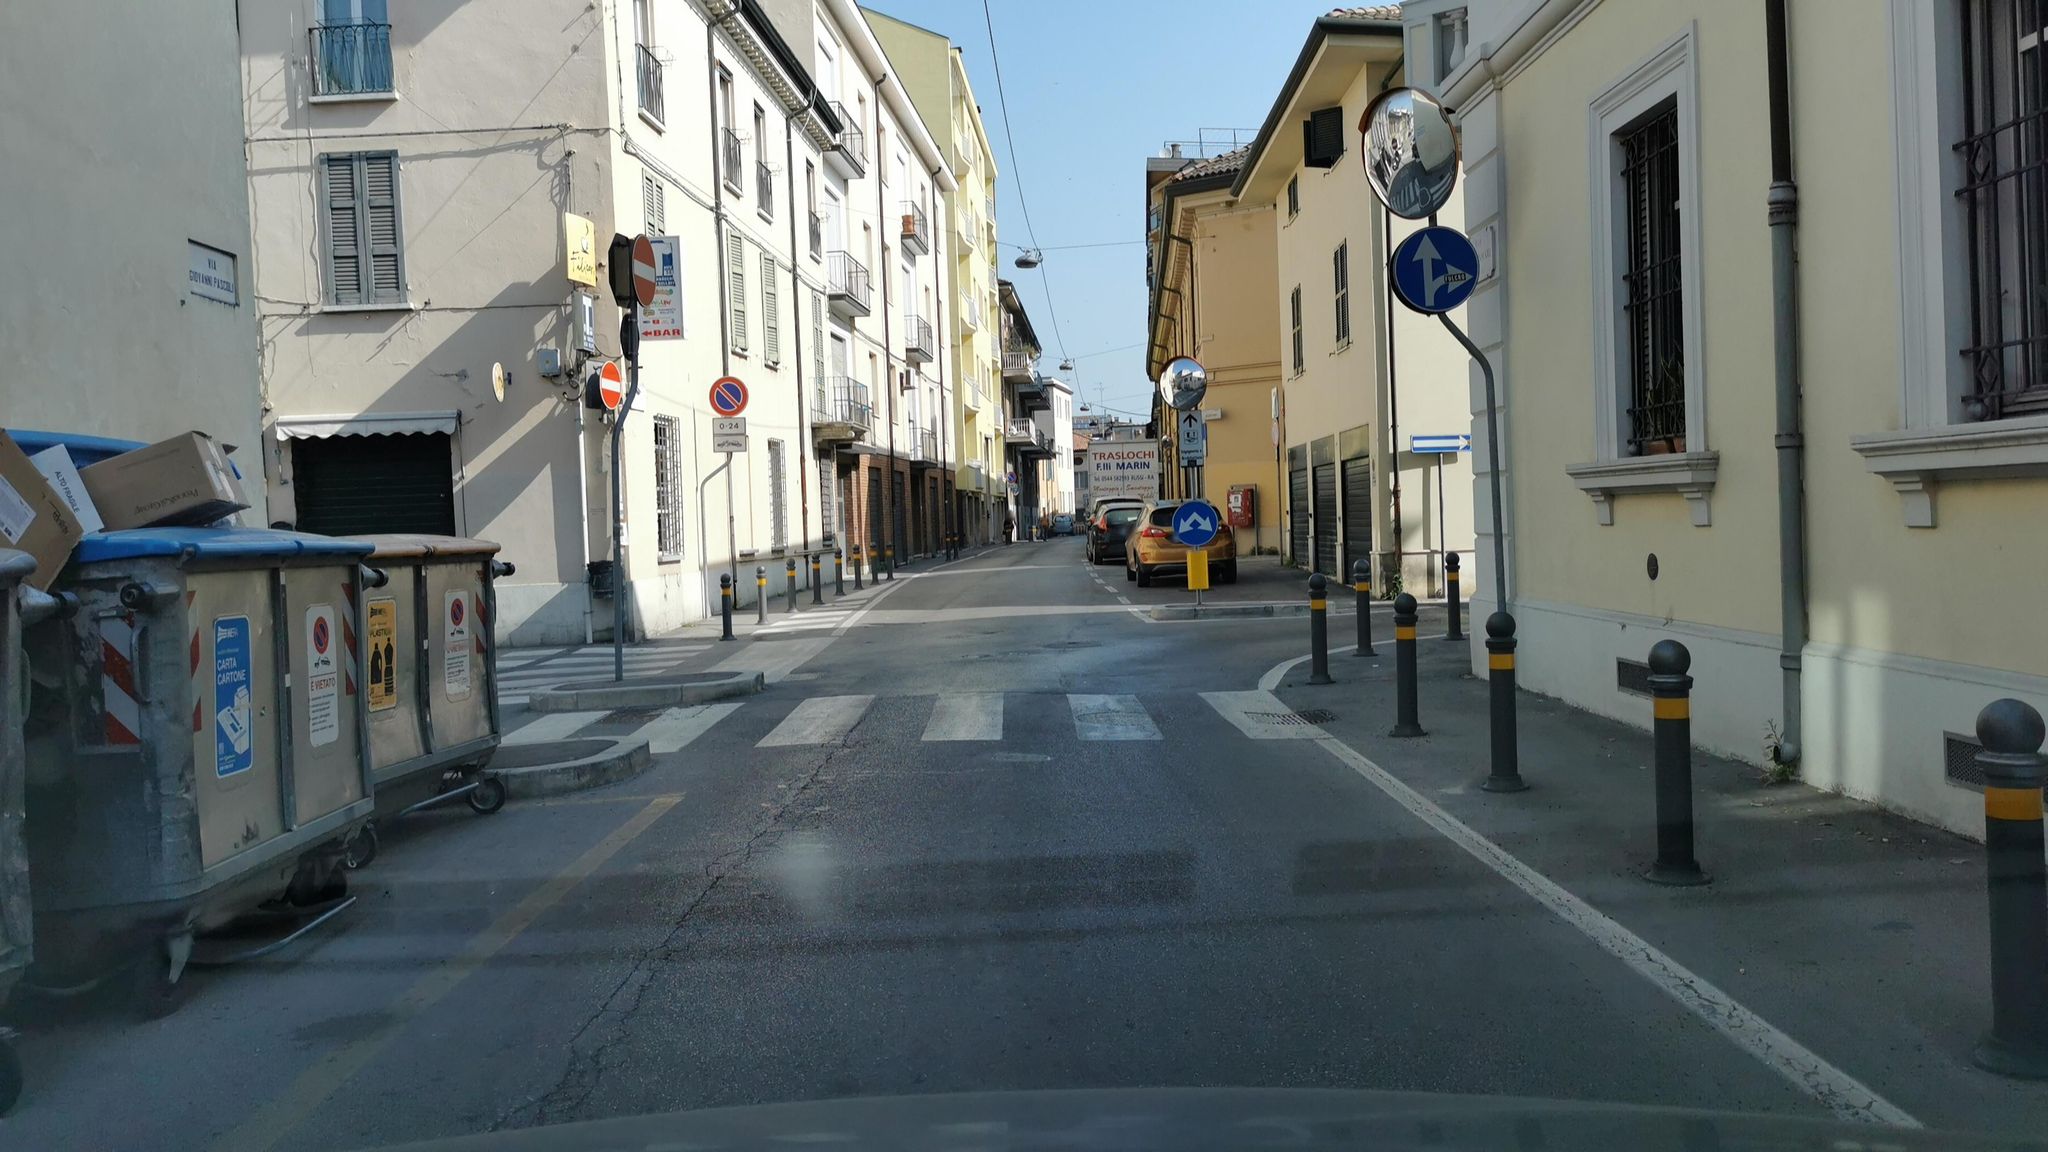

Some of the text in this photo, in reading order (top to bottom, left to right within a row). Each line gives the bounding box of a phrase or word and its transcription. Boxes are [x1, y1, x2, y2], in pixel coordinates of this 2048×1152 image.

[207, 258, 217, 270] VIA
[189, 270, 234, 293] GIOVANNI PASCOLI
[653, 328, 681, 337] BAR
[1092, 451, 1154, 460] TRASLOCHI
[1116, 461, 1150, 470] MARIN
[55, 470, 80, 513] ALTO FRAGILE
[217, 657, 237, 672] CARTA
[217, 670, 246, 686] CARTONE
[315, 678, 336, 690] VIETATO
